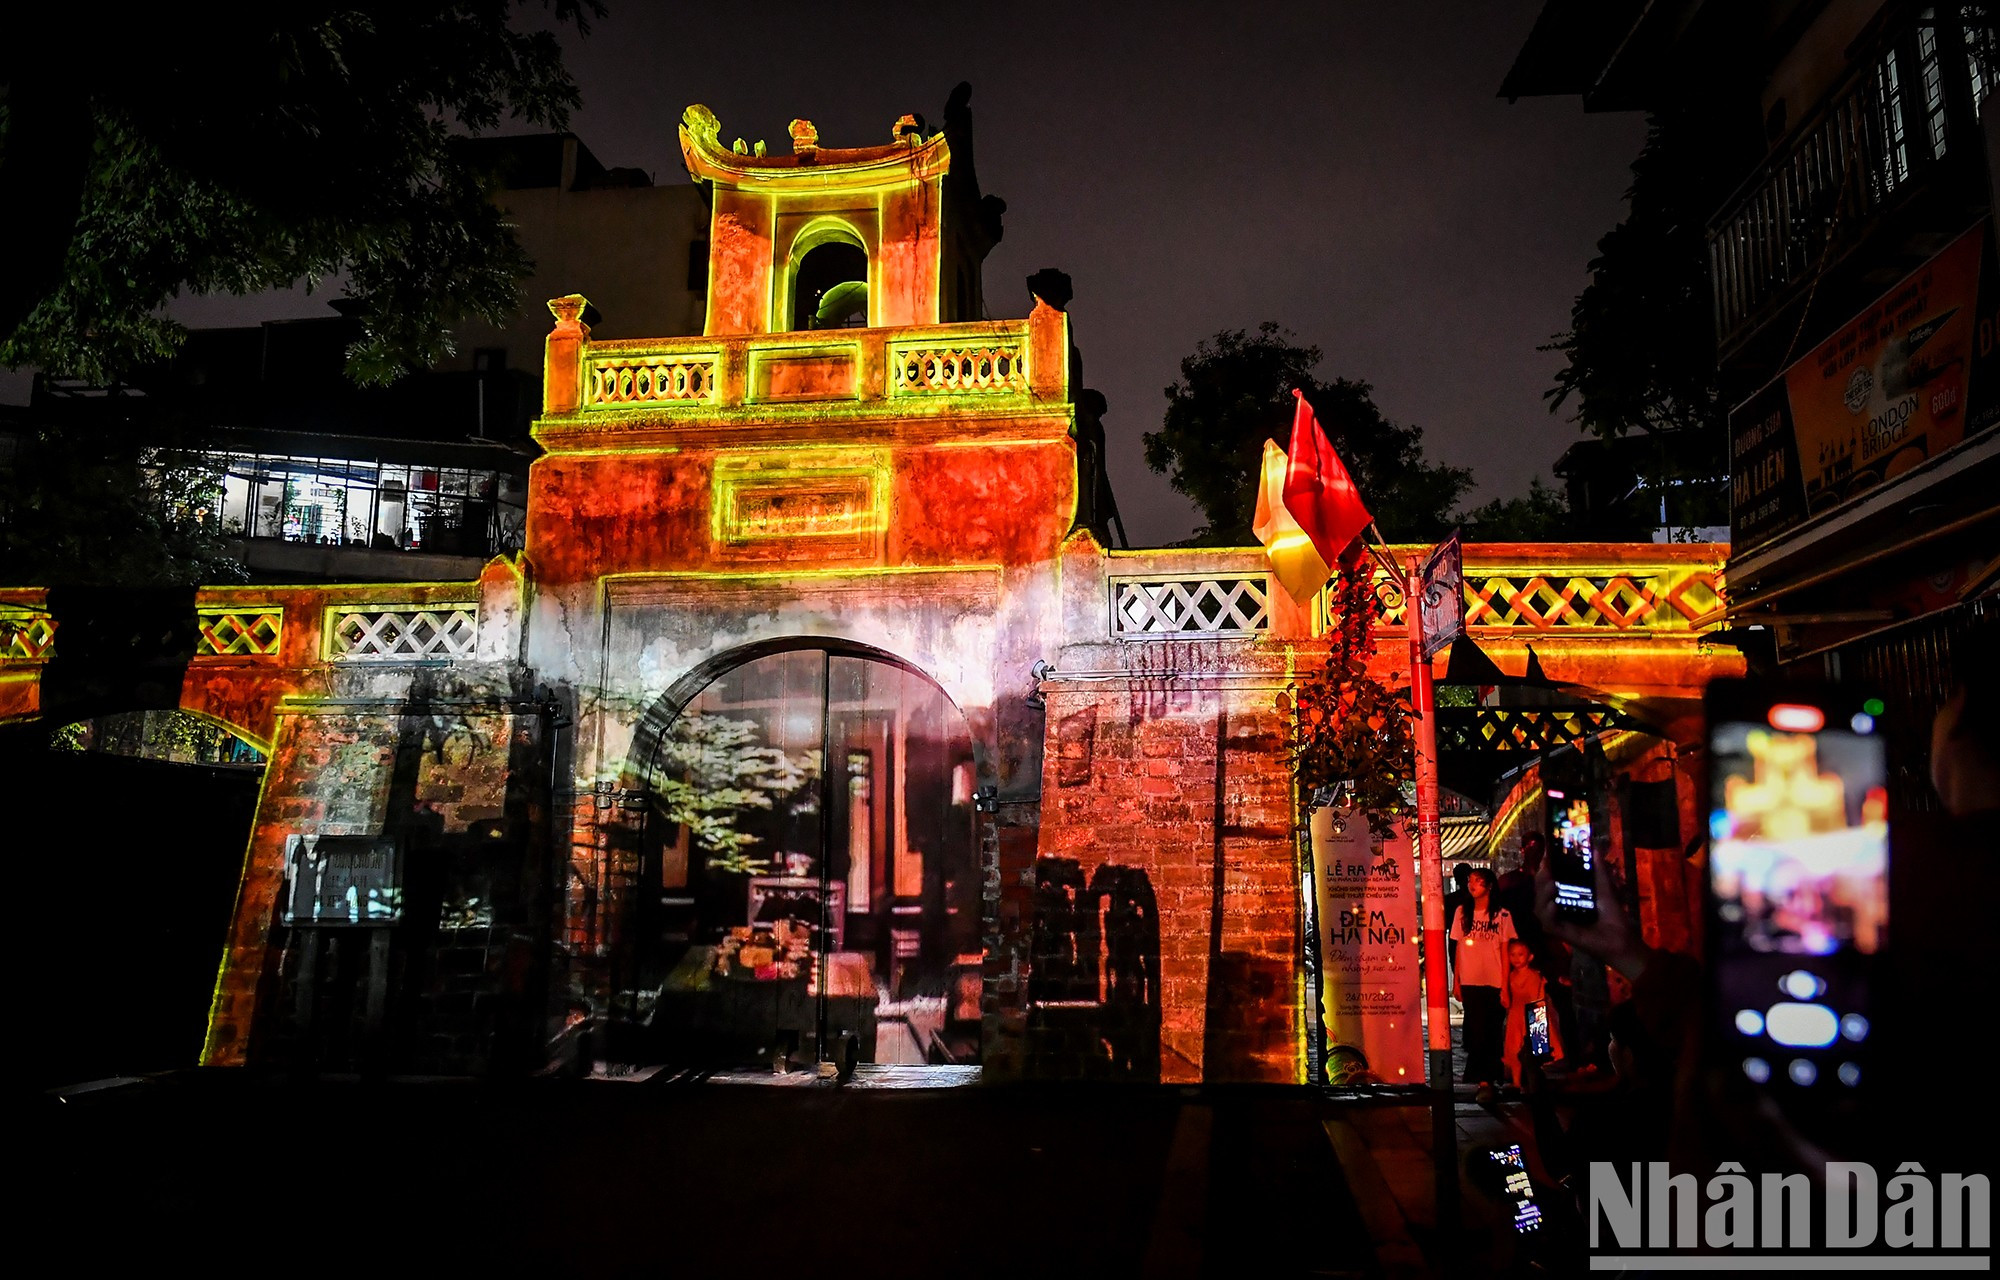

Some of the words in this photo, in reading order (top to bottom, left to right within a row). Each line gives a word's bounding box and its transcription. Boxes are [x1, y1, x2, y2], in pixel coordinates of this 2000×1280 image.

[1861, 392, 1920, 441] LONDON
[1862, 421, 1909, 460] BRIDGE
[1326, 860, 1343, 876] LỄ
[1347, 865, 1366, 876] RA
[1339, 904, 1387, 927] ĐÊM
[1368, 923, 1405, 949] NỘI
[1345, 992, 1395, 1001] 24/11/2023
